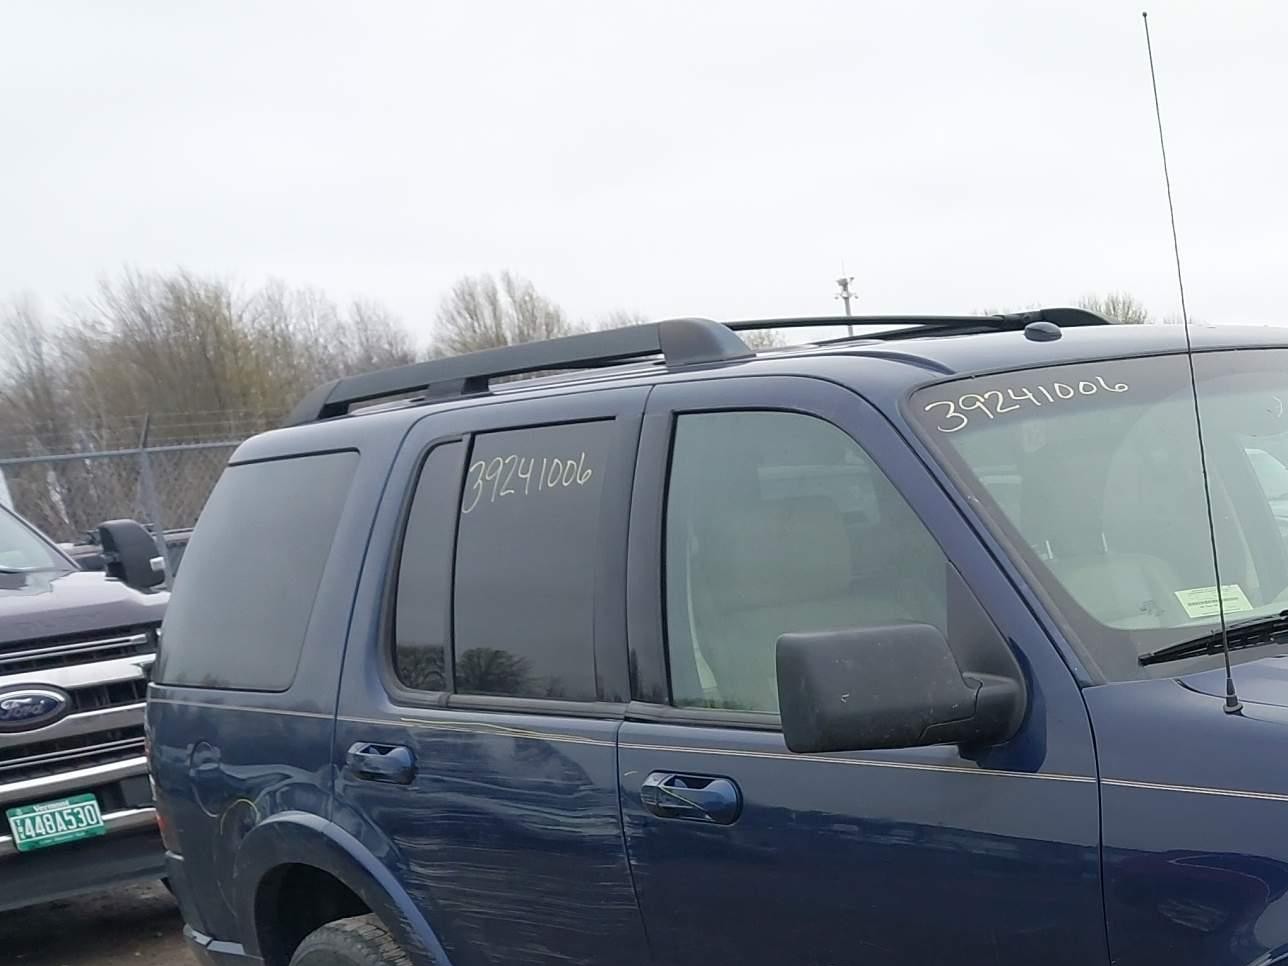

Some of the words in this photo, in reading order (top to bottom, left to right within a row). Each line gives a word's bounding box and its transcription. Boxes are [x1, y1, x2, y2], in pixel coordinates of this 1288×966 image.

[925, 376, 1129, 432] 39241006
[461, 452, 592, 514] 39241006
[0, 697, 45, 719] Ford
[24, 805, 98, 838] 448A530
